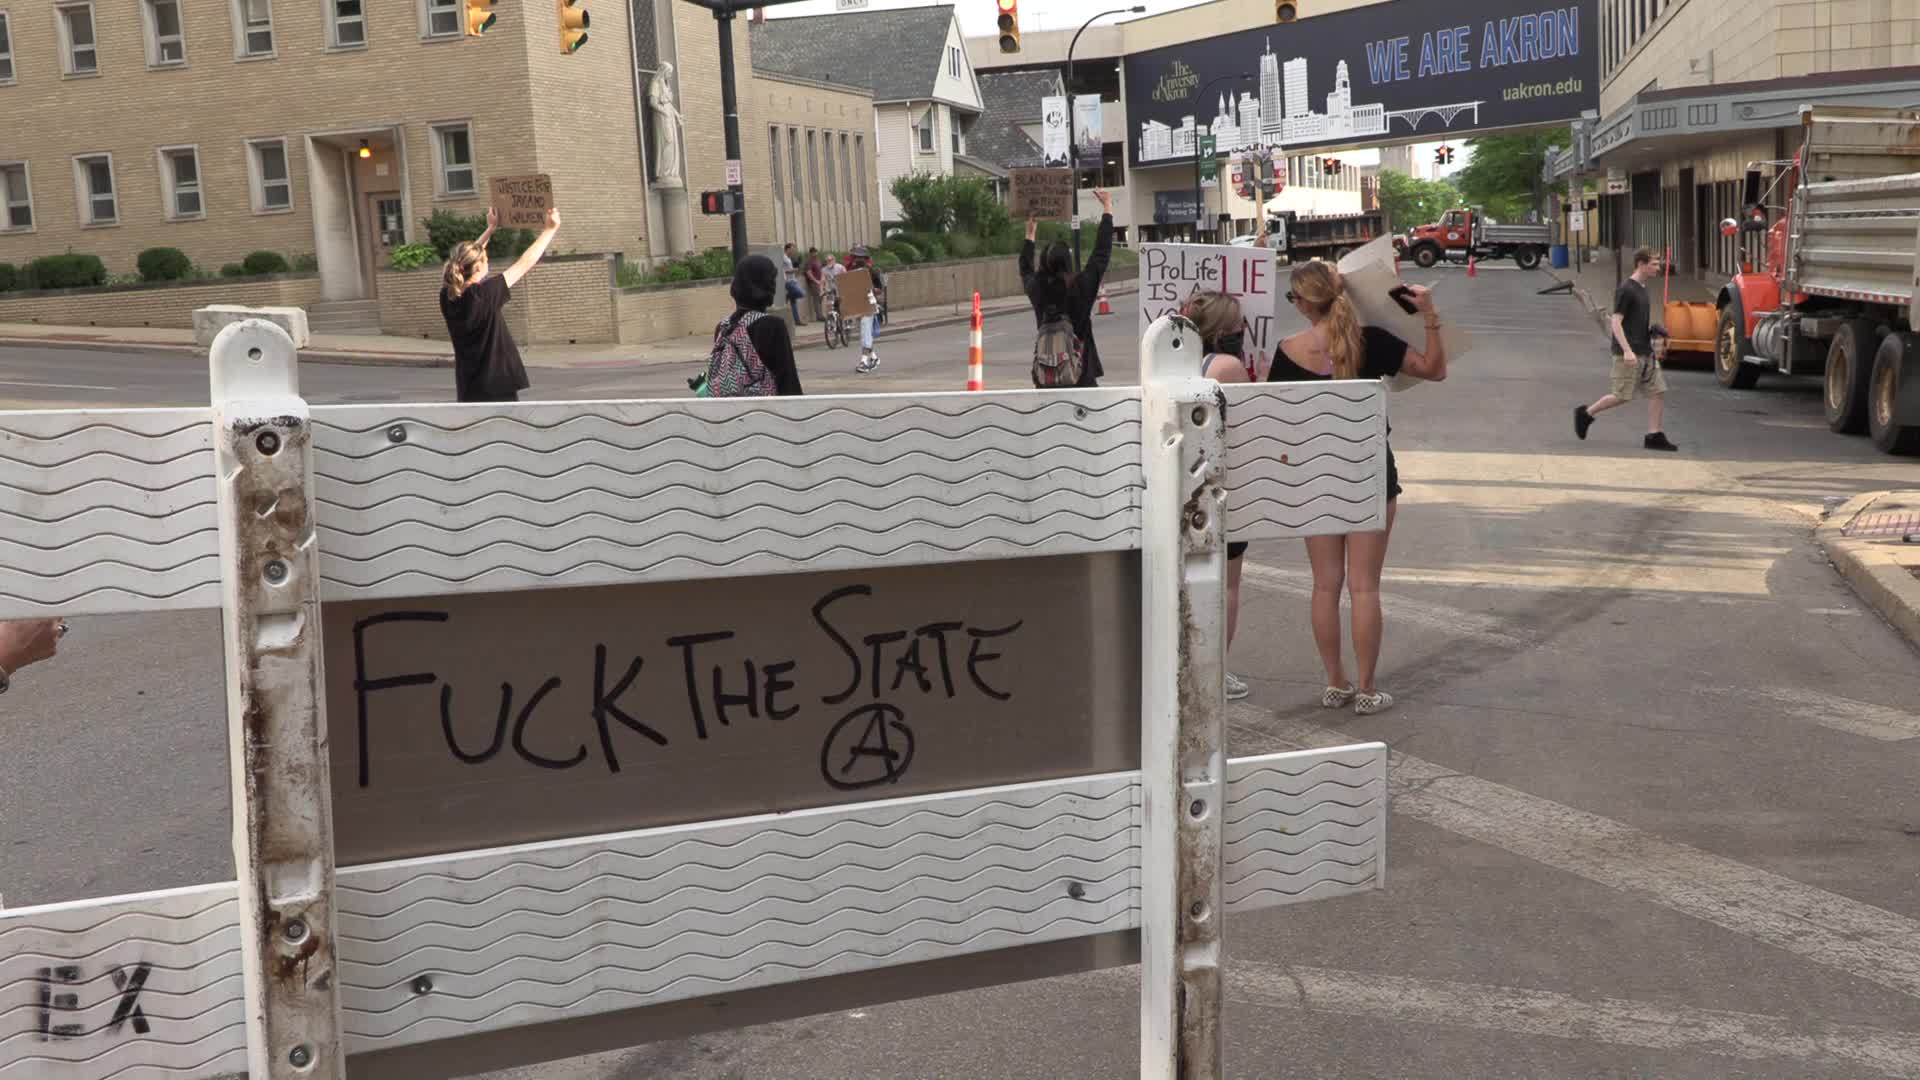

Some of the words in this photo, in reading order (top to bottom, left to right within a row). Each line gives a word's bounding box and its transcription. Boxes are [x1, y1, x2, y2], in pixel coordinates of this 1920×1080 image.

[1366, 36, 1410, 84] WE
[1418, 25, 1472, 78] ARE
[1479, 6, 1579, 69] AKRON
[1502, 77, 1583, 101] uakron.edu
[1147, 283, 1178, 300] IS
[1221, 255, 1268, 297] LIE
[353, 610, 668, 788] FUCK
[667, 631, 801, 739] THE
[811, 584, 1023, 703] STATE
